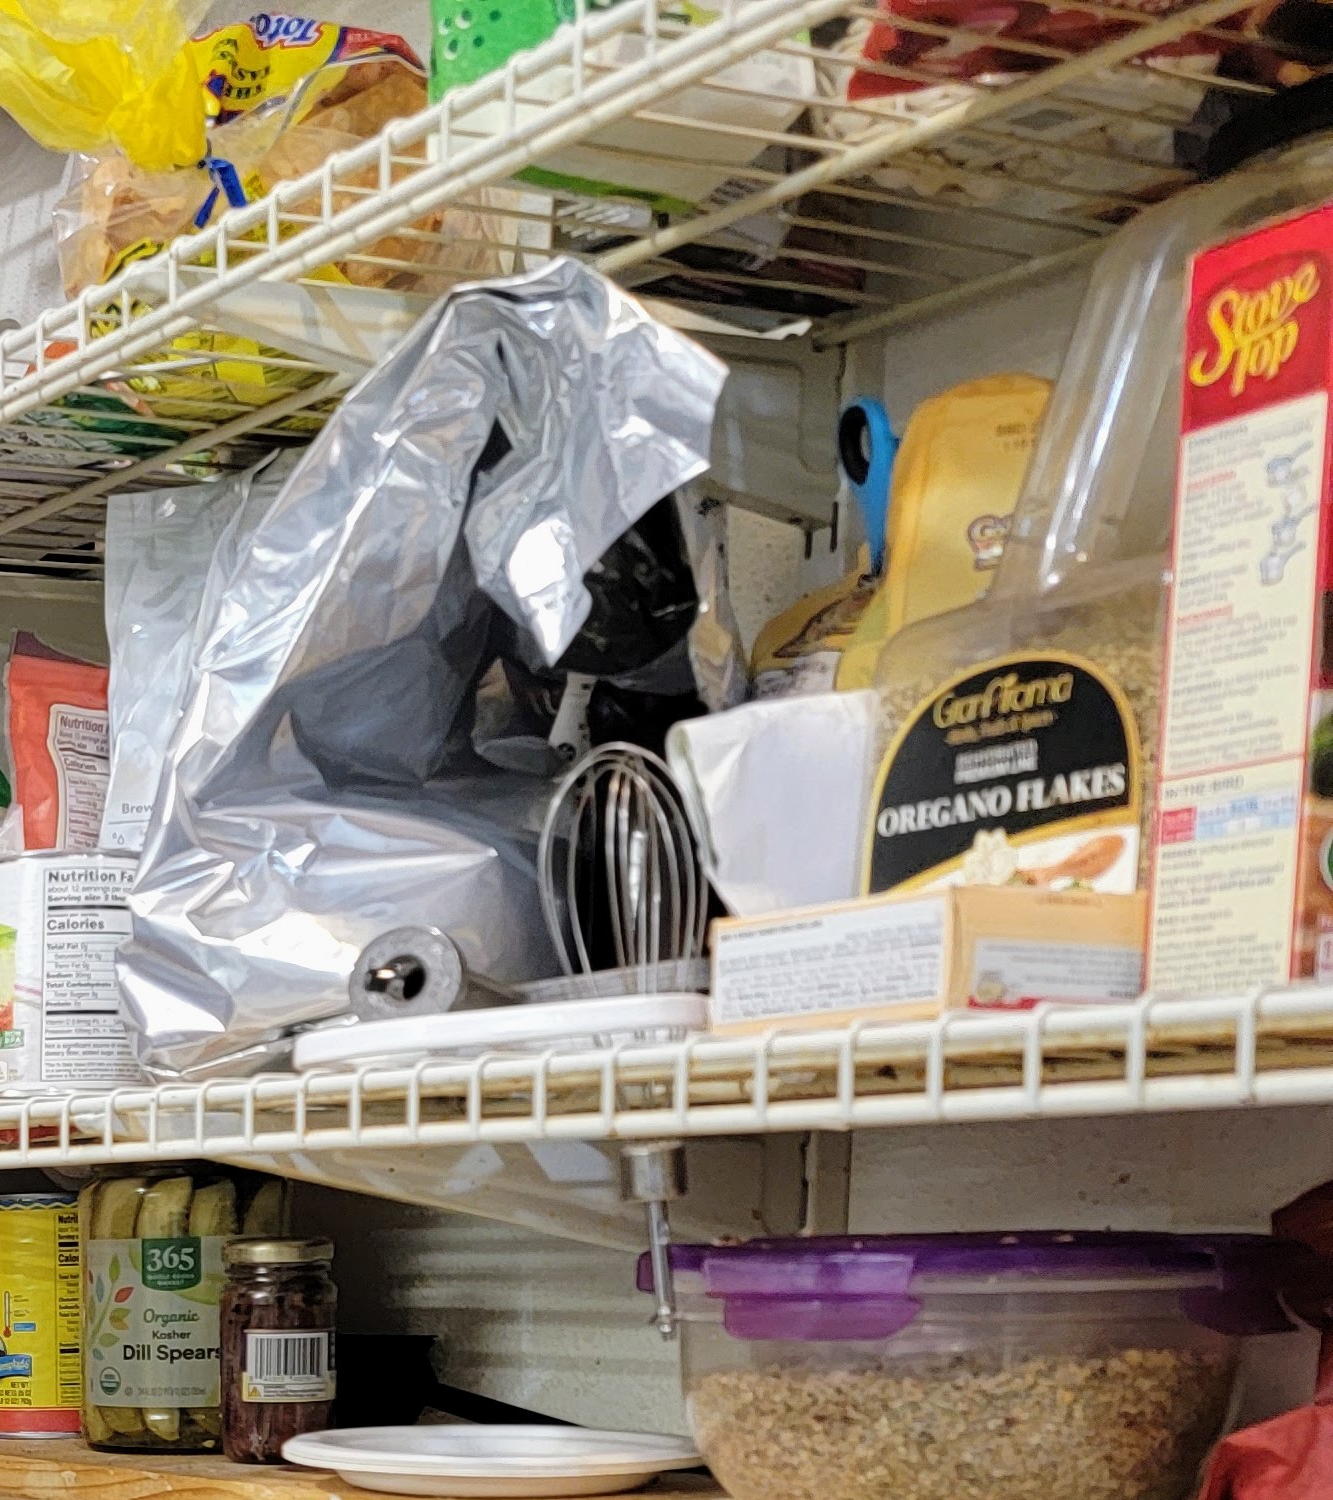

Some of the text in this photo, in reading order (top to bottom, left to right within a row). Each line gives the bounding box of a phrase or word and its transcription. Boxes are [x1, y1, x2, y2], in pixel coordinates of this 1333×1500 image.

[1189, 262, 1320, 388] Stove
[59, 715, 105, 733] Nutrition
[878, 762, 1126, 838] OREGANO FLAKES
[47, 871, 116, 884] Nutrition
[46, 918, 105, 930] Calories
[145, 1245, 196, 1272] 365
[142, 1307, 200, 1327] Organic
[151, 1330, 191, 1340] Kosher
[122, 1345, 151, 1362] Dill
